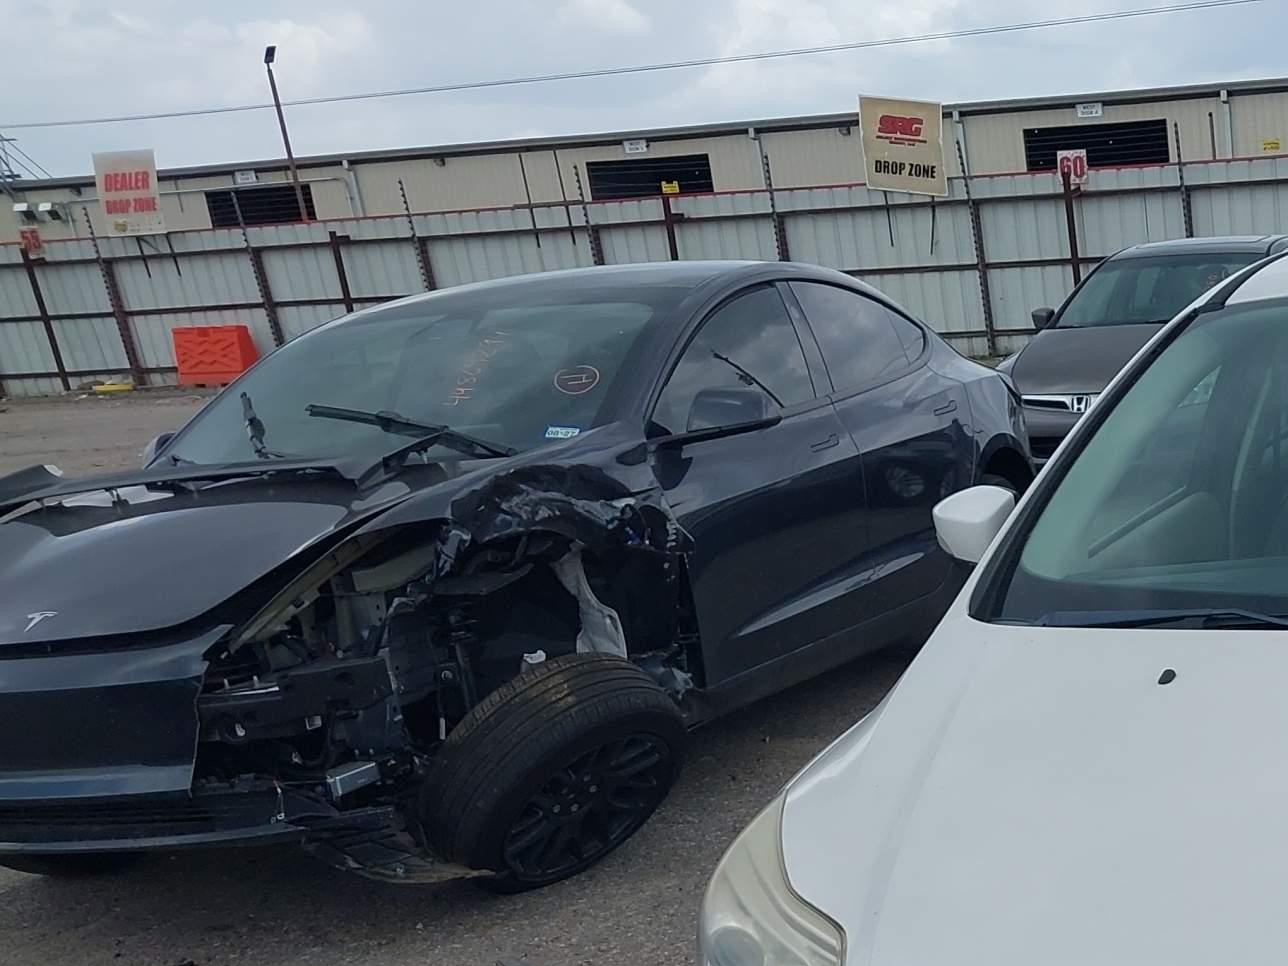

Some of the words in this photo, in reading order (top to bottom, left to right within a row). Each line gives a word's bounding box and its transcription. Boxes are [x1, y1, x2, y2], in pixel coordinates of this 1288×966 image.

[875, 160, 906, 176] DROP
[908, 163, 937, 179] ZONE
[1060, 156, 1085, 178] 60
[104, 170, 150, 193] DEALER
[105, 199, 132, 215] DROP
[133, 196, 157, 212] ZONE
